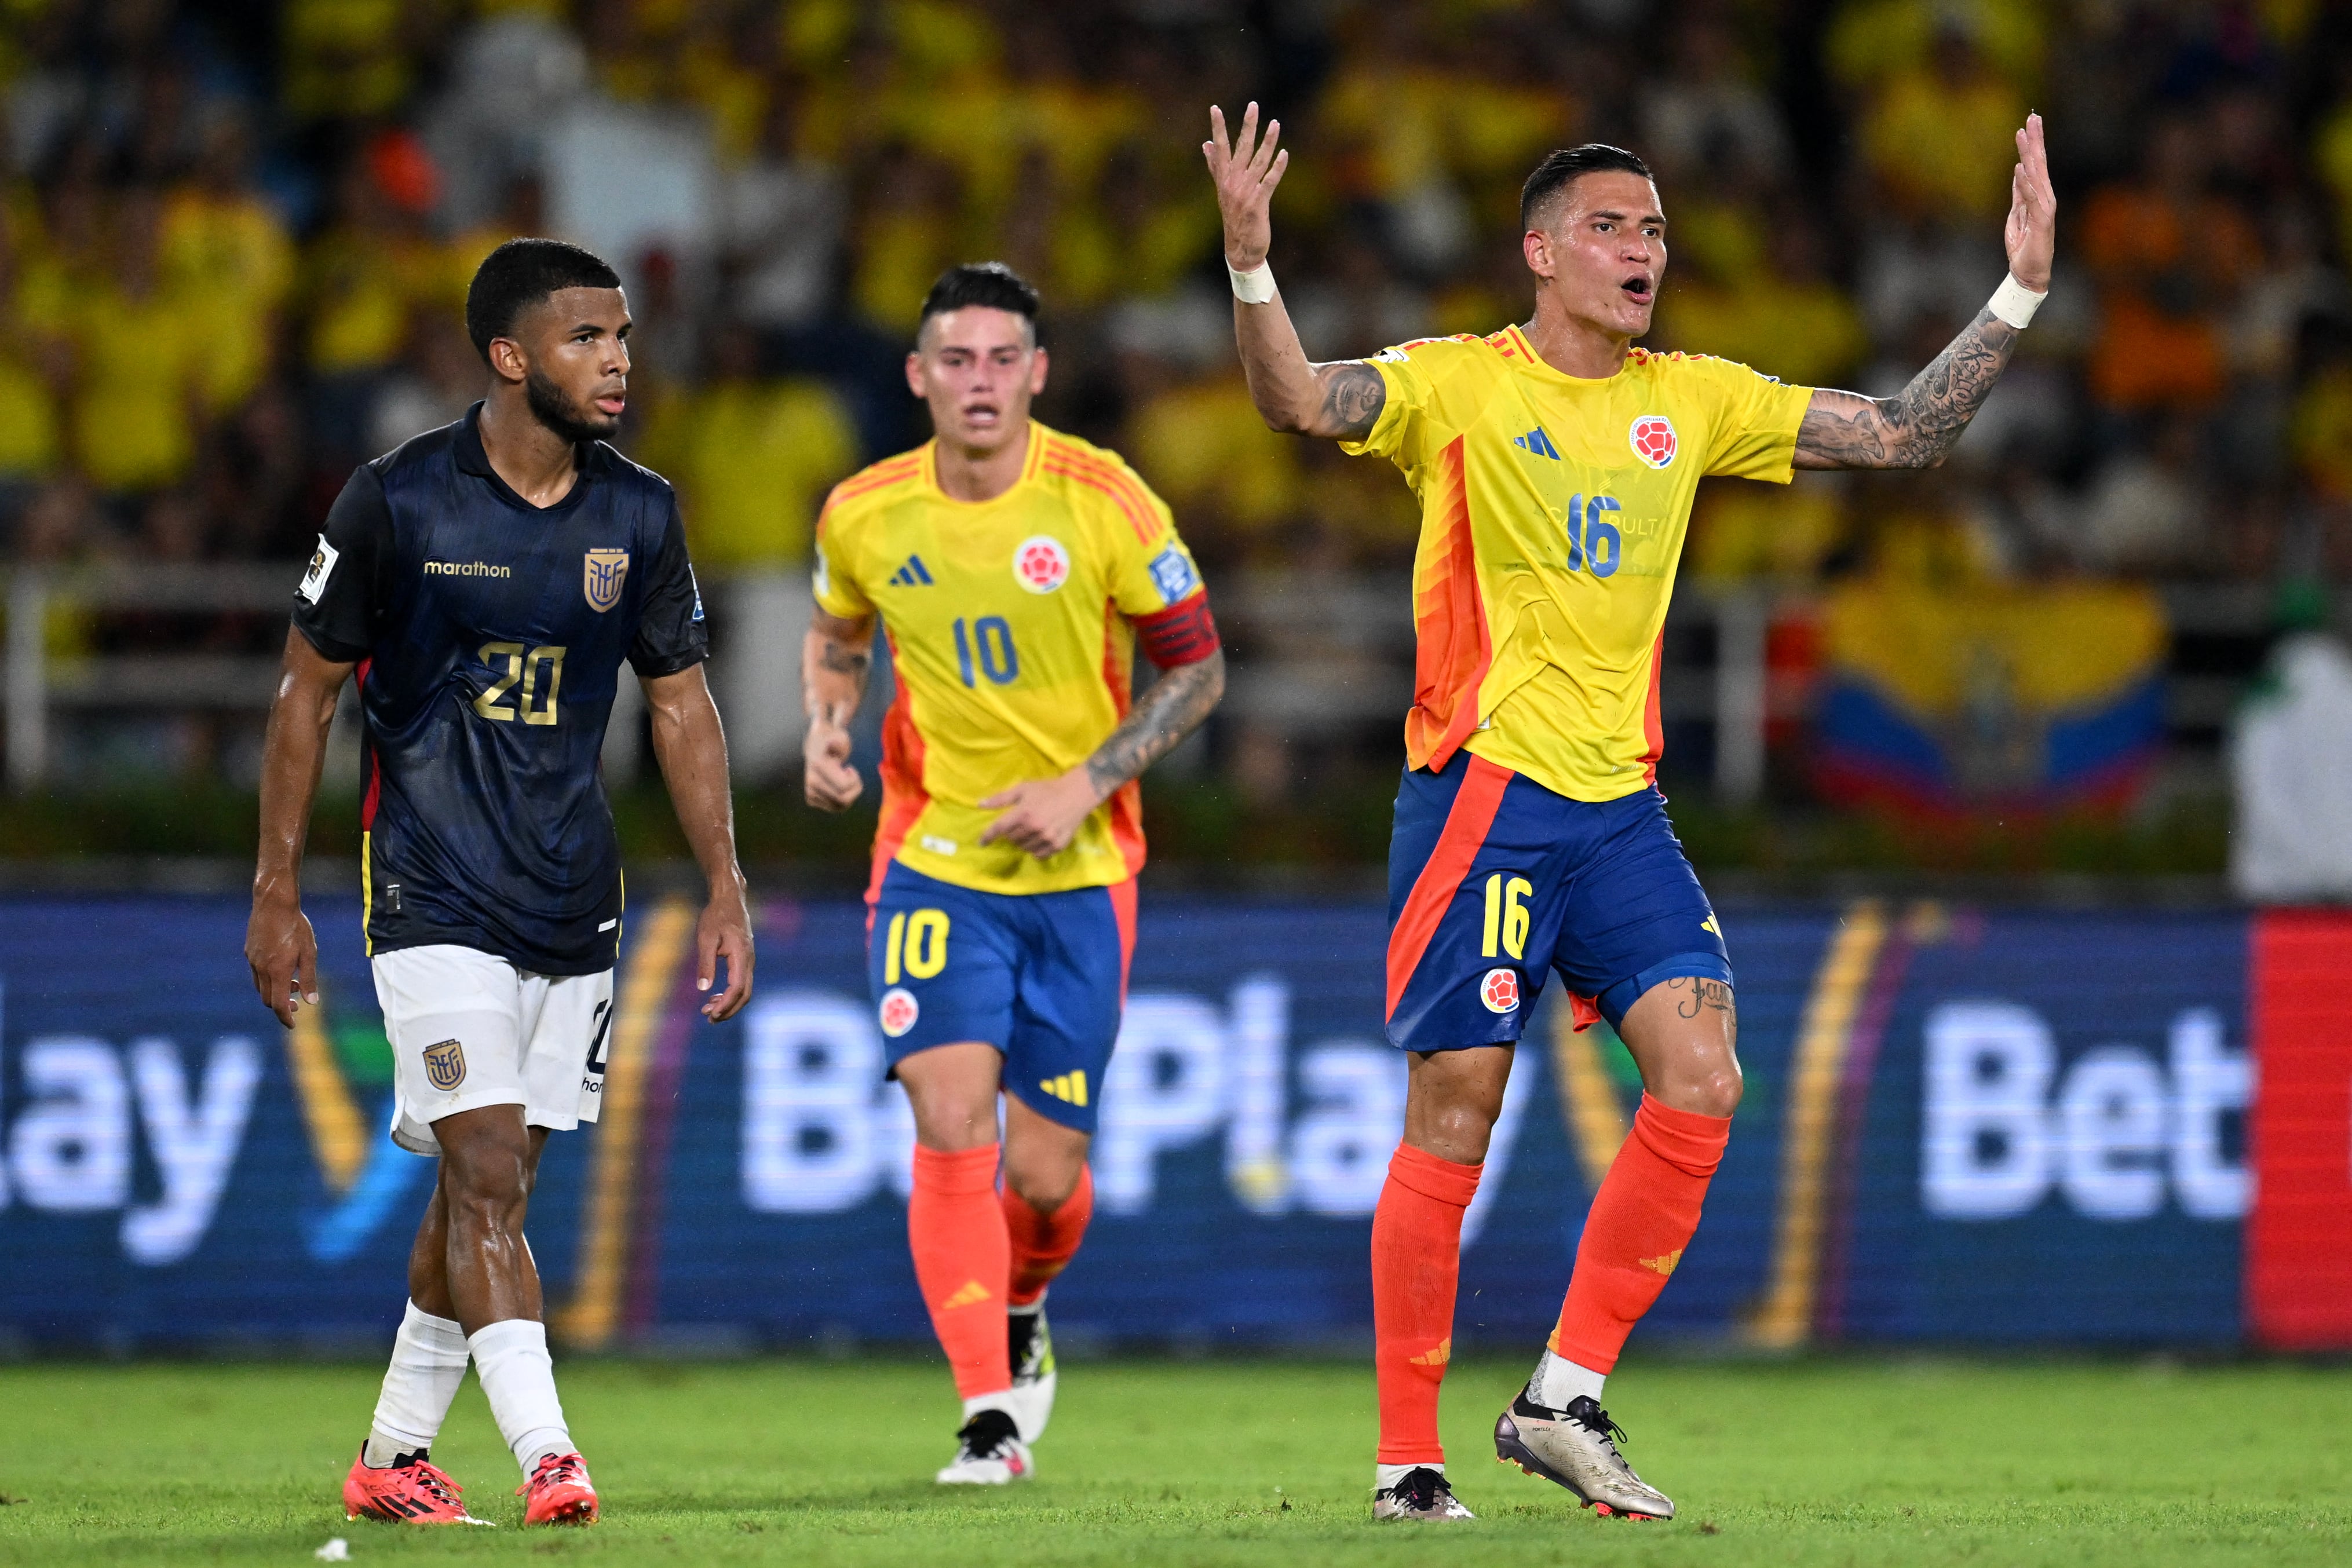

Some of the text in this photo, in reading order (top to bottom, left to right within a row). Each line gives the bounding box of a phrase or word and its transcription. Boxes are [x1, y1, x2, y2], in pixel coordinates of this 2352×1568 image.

[424, 561, 510, 578] marathon
[1568, 493, 1621, 578] 16
[473, 642, 567, 725] 20
[952, 617, 1019, 688] 10
[885, 908, 950, 985] 10
[1481, 873, 1533, 960] 16
[0, 1031, 262, 1267] ay
[1920, 1001, 2257, 1221] Bet
